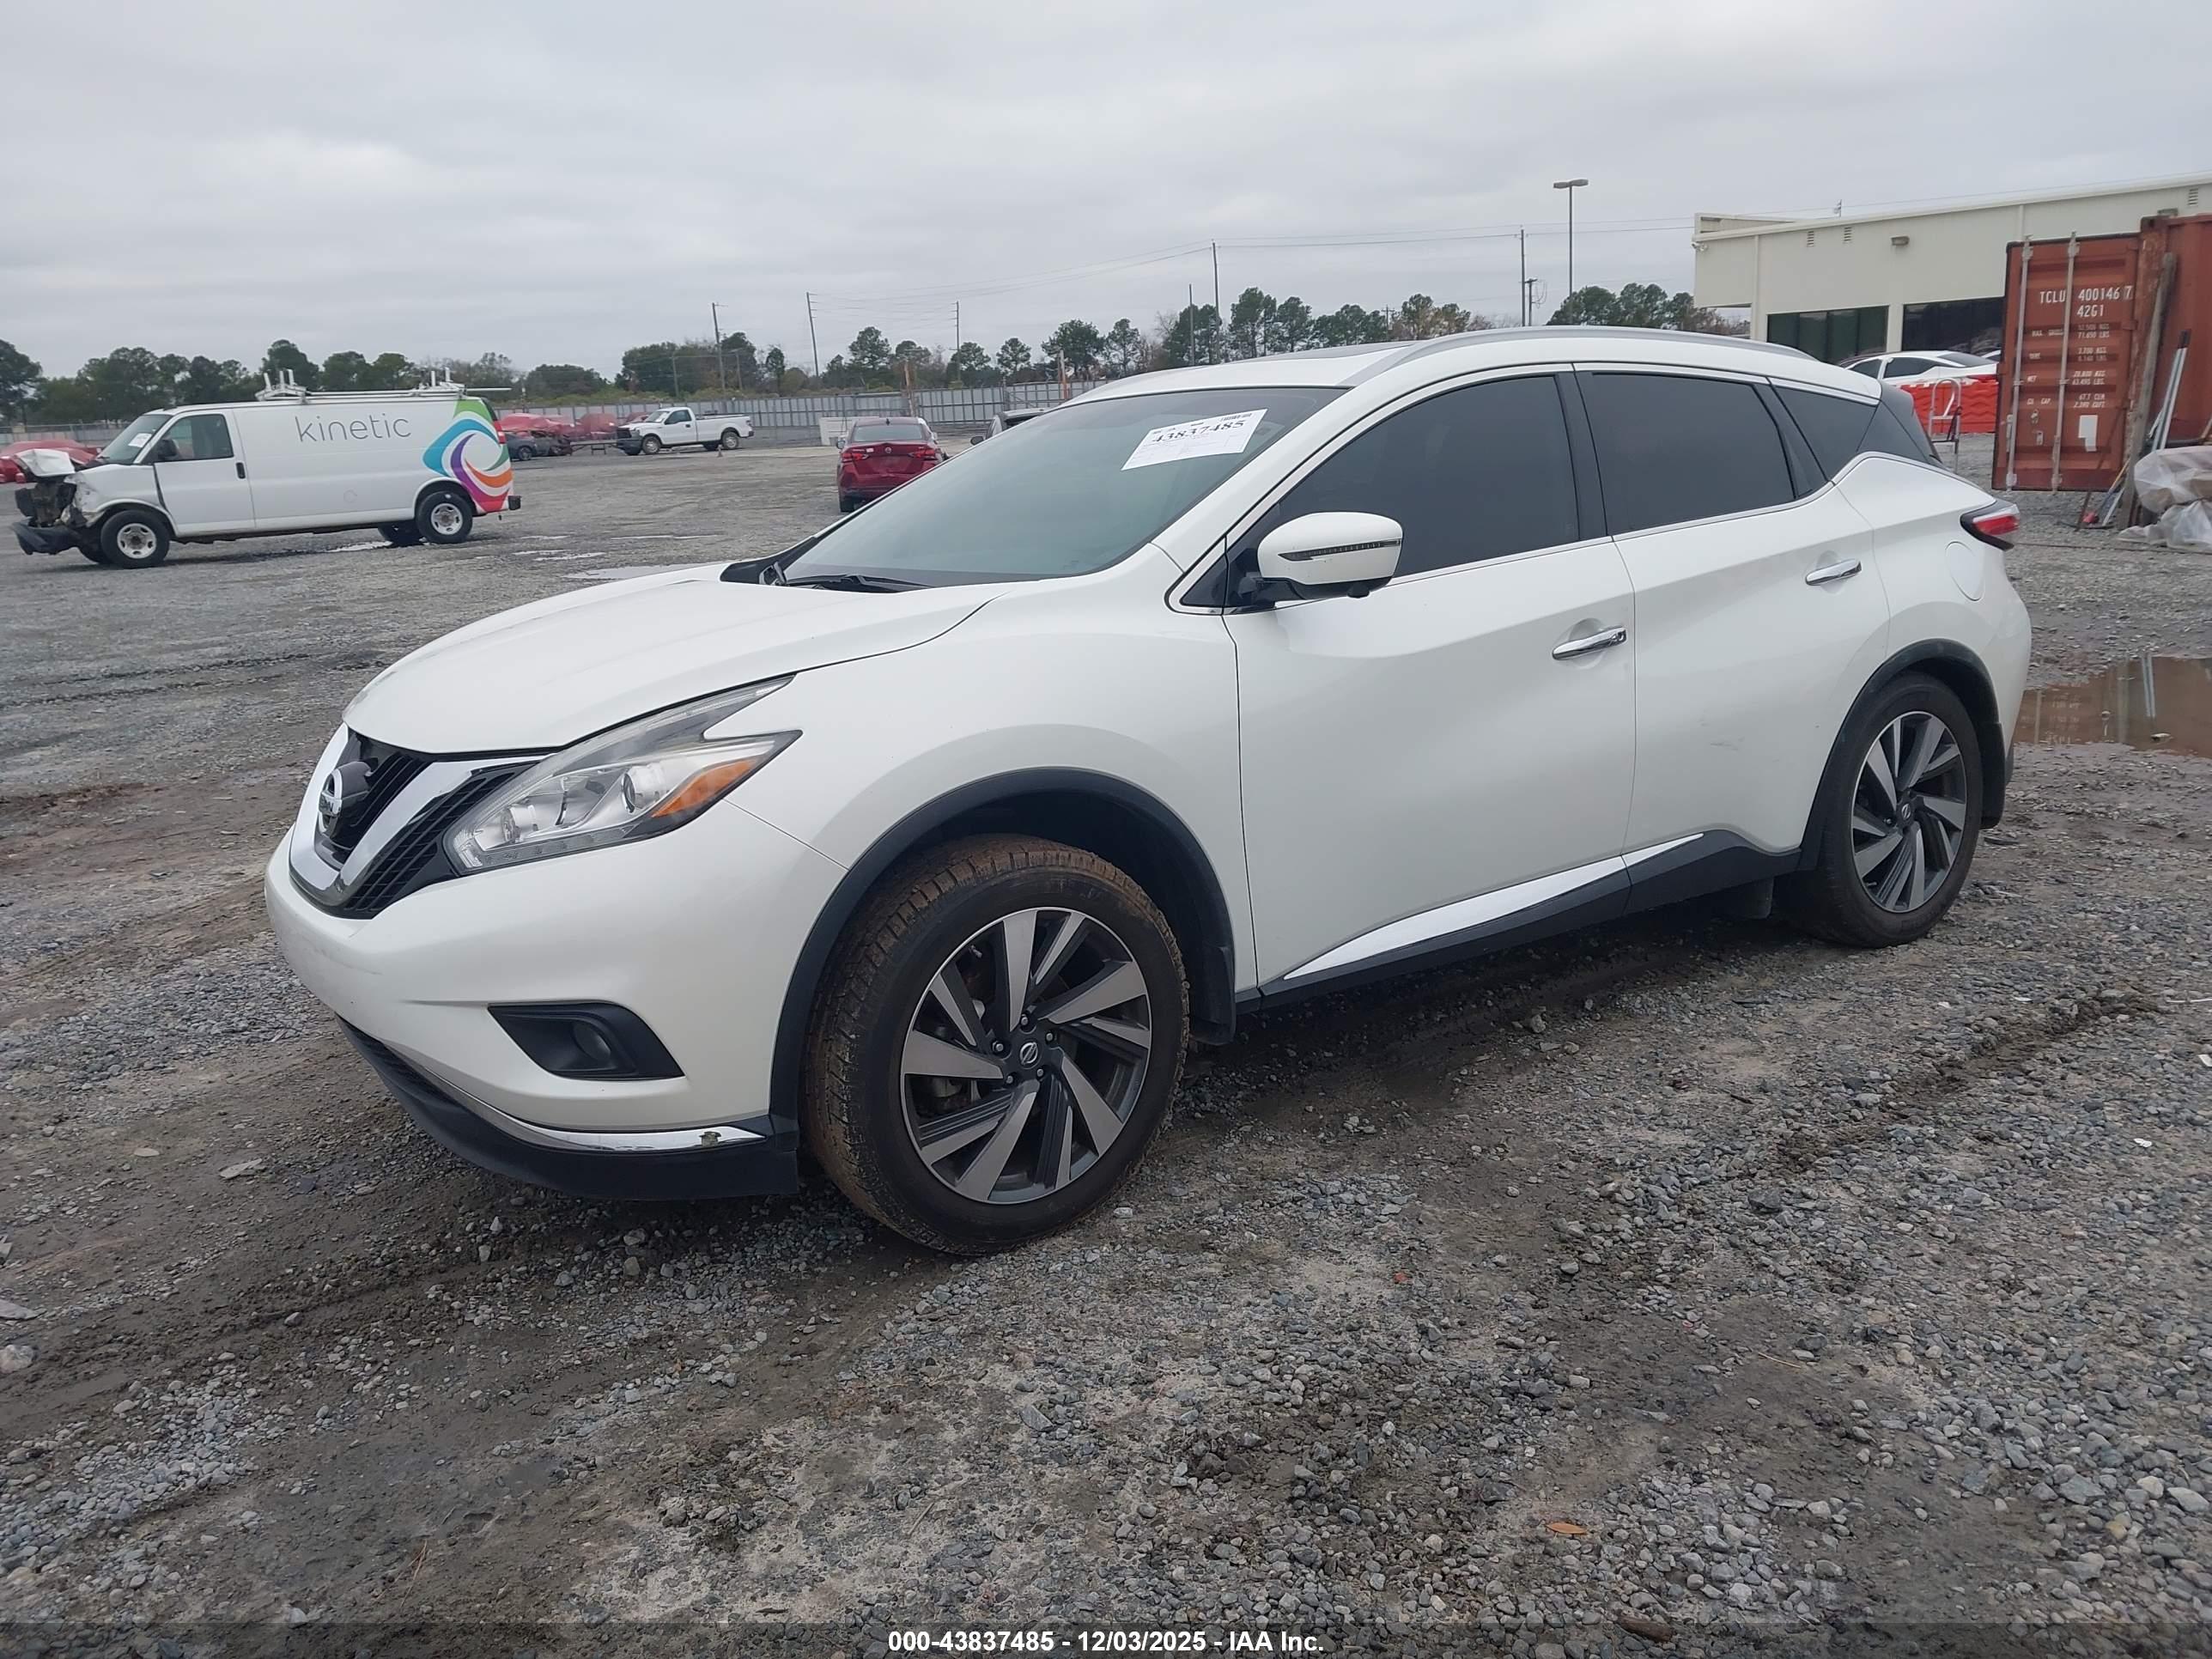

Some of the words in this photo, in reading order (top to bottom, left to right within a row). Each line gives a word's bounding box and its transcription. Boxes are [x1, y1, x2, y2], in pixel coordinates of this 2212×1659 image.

[2039, 290, 2066, 304] TCLU
[2077, 304, 2105, 318] 42G1
[295, 413, 411, 442] kinetic
